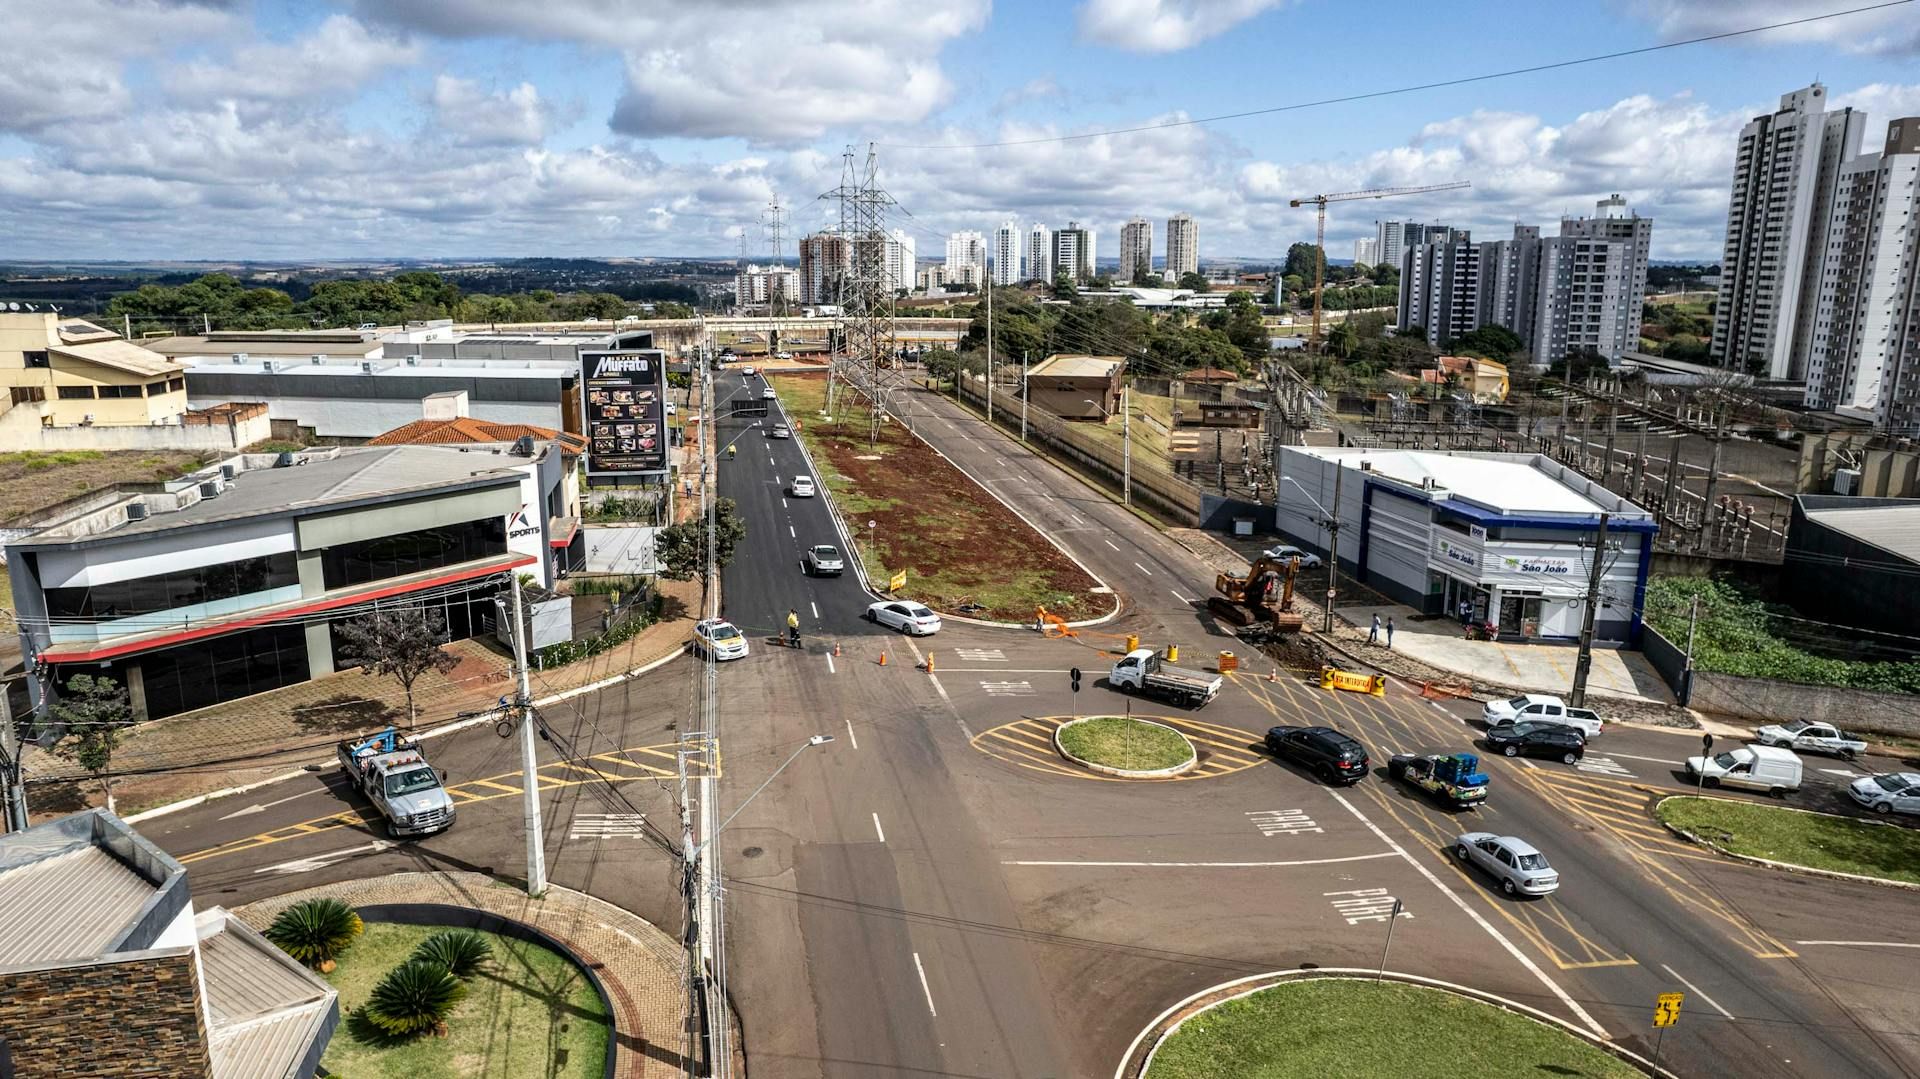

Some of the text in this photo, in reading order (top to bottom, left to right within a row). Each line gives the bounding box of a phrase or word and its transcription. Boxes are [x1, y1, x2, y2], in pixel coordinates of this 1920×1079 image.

[592, 356, 648, 378] Muffato
[509, 527, 541, 539] SPORTS
[1544, 564, 1568, 573] João
[570, 813, 647, 840] PARE
[1244, 808, 1325, 837] PARE
[1323, 887, 1415, 925] PARE
